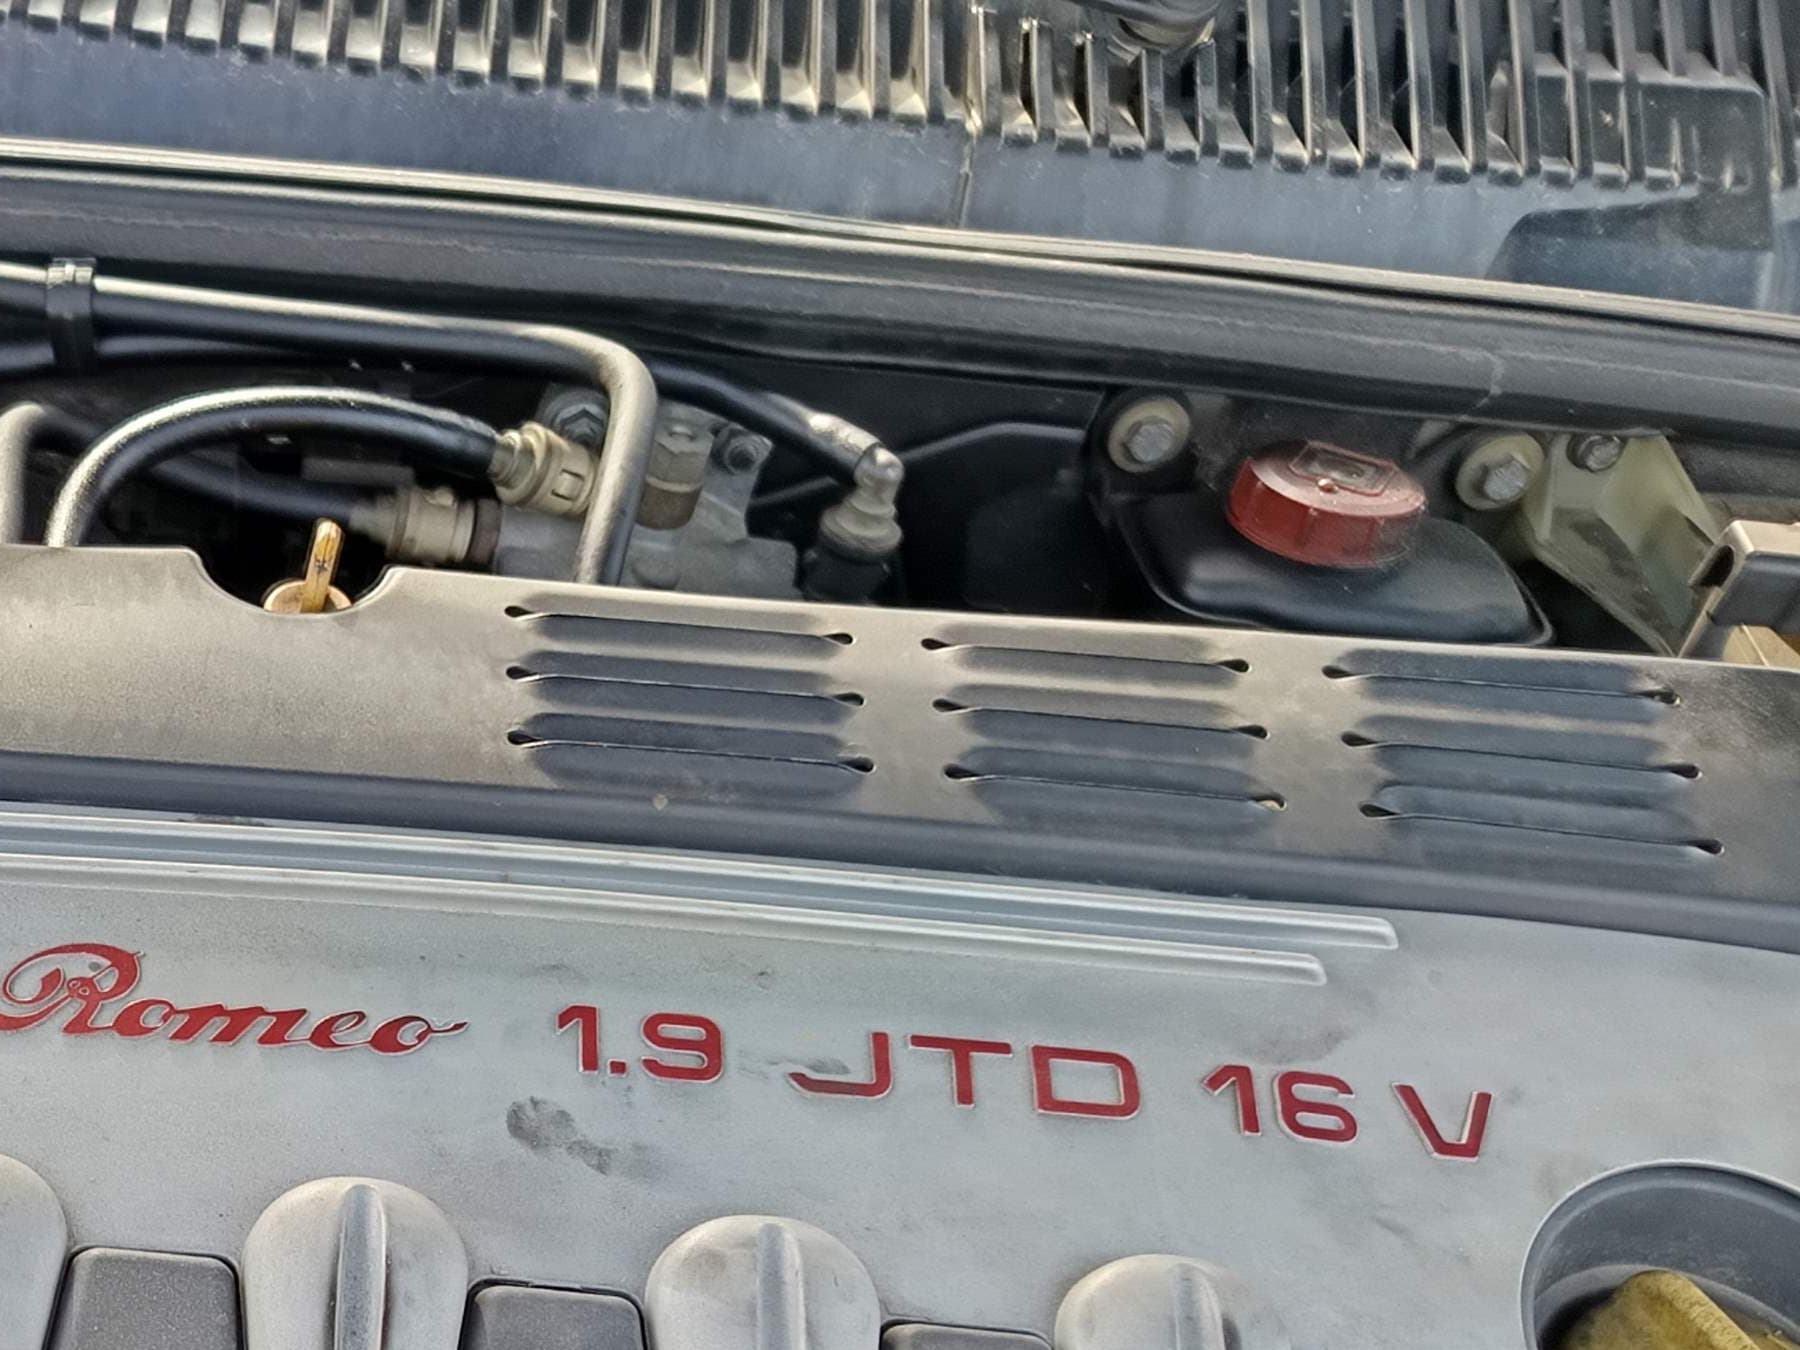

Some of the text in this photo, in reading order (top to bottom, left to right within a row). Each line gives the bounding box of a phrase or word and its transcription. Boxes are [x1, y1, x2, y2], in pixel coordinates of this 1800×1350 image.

[555, 1003, 1494, 1162] 1.9 JTD 16 V
